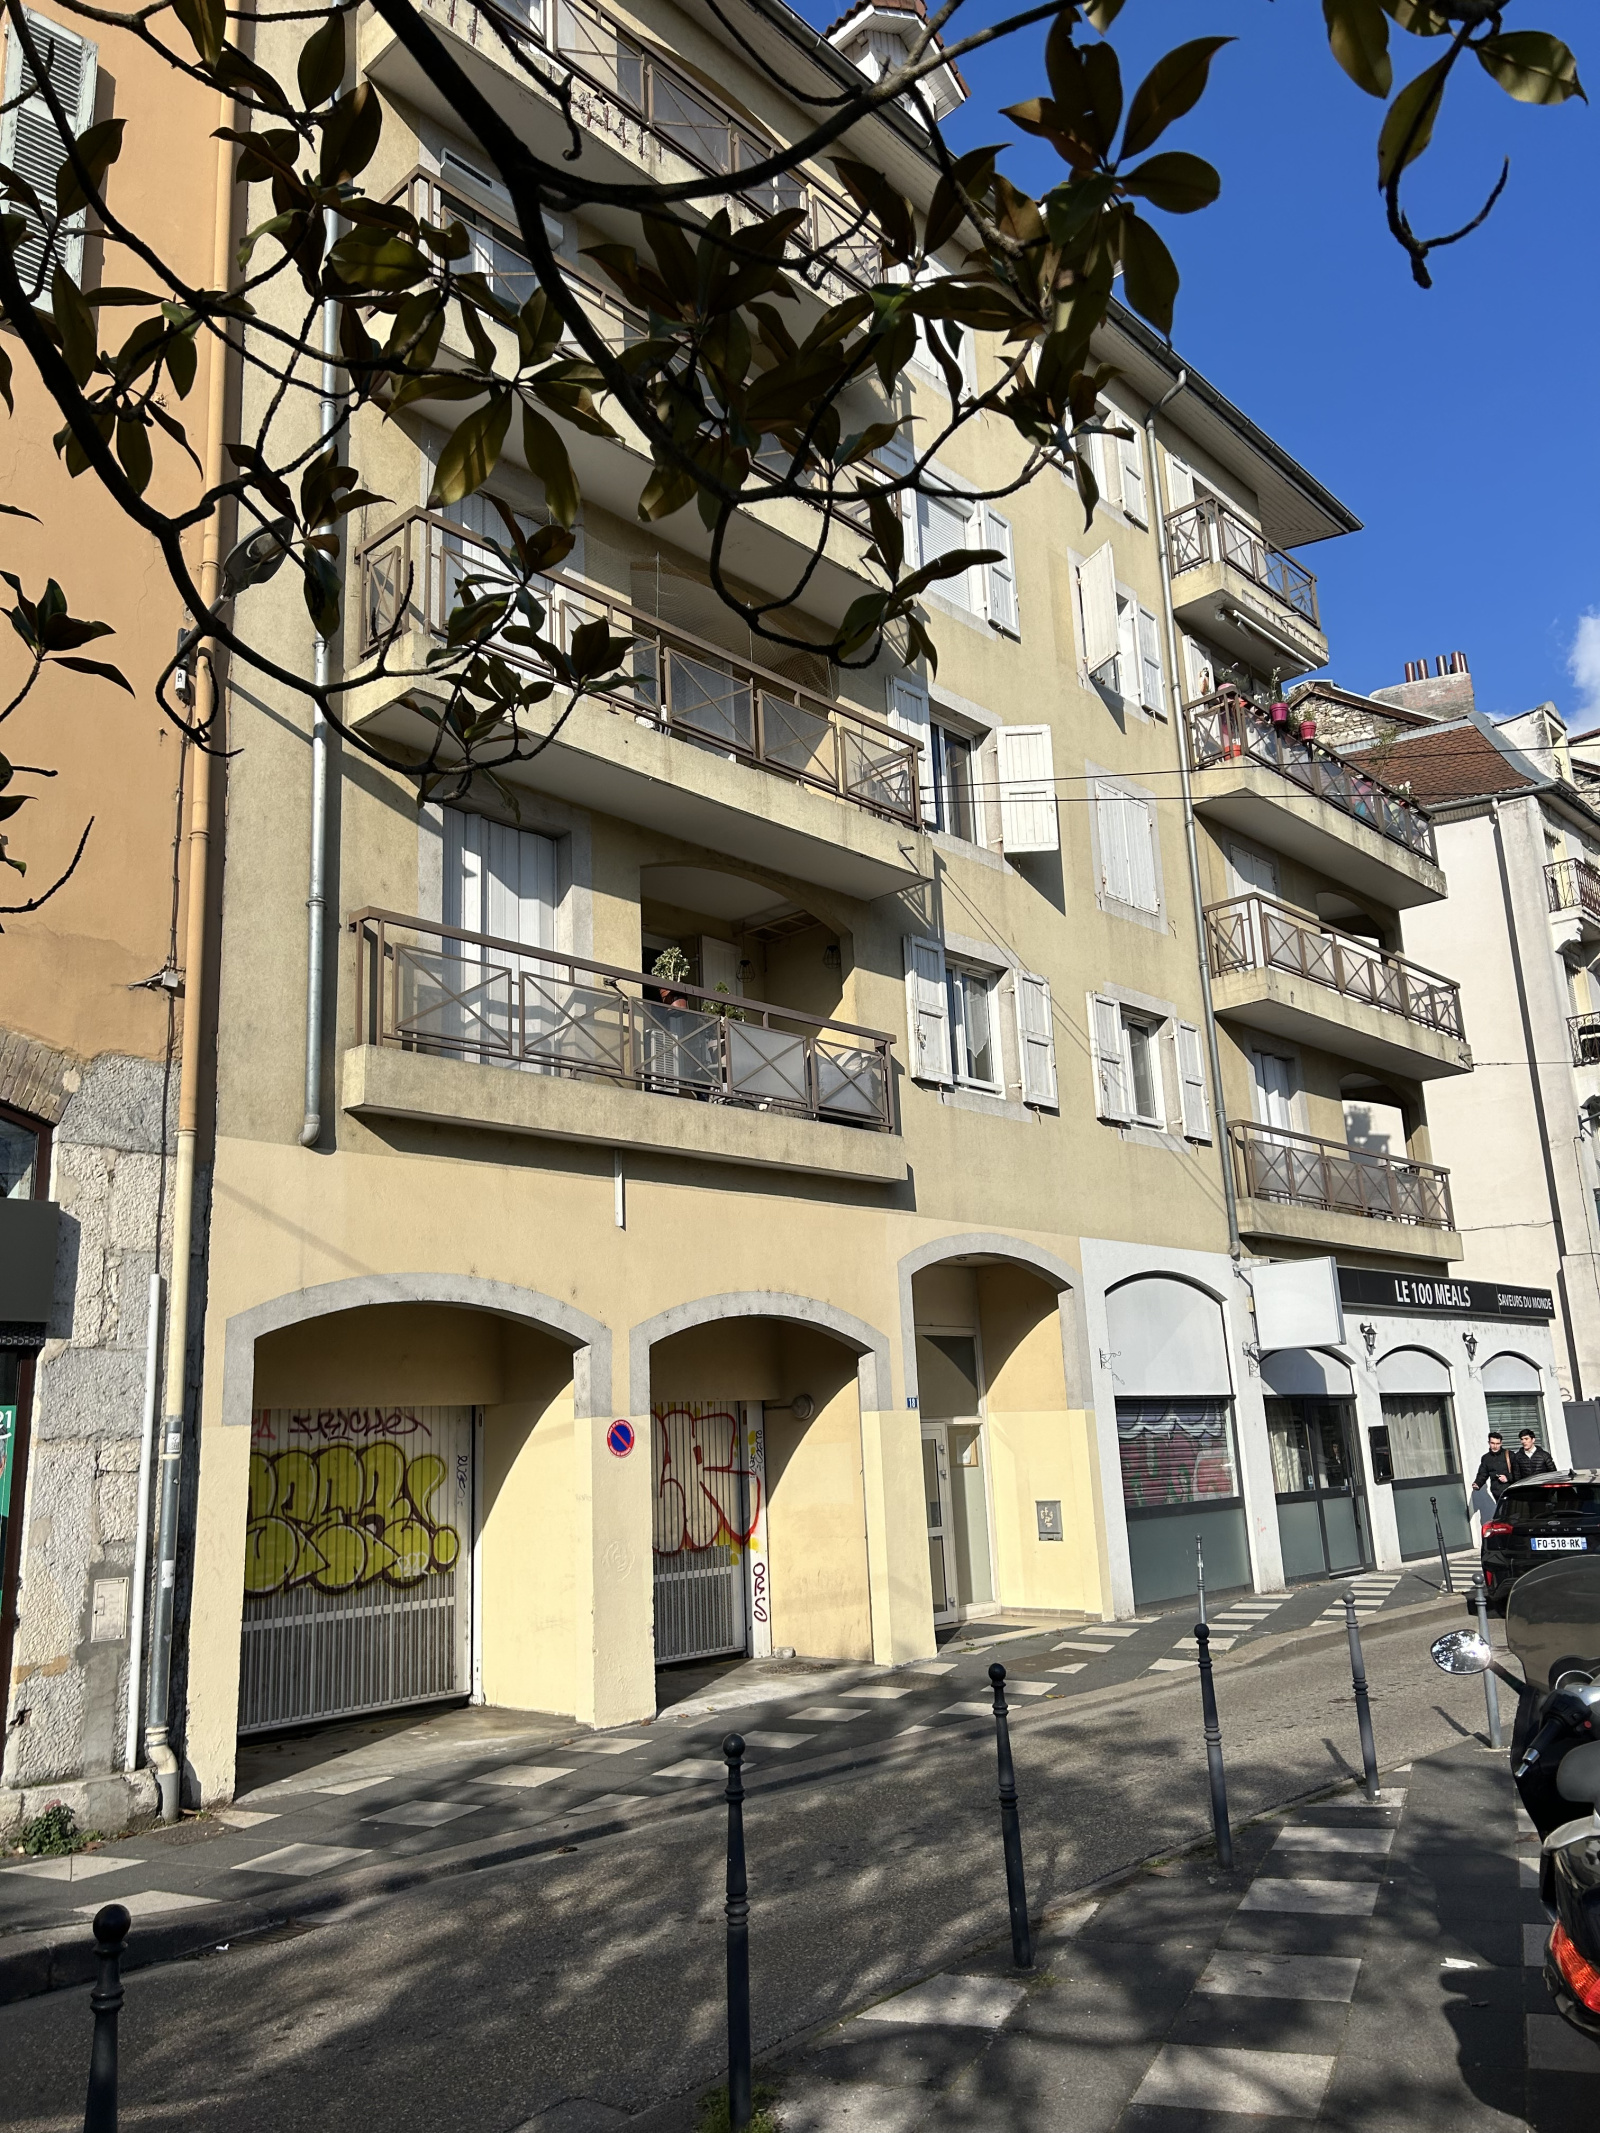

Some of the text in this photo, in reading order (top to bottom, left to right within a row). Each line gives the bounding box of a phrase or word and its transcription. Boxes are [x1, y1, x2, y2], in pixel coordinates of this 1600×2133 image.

[1394, 1279, 1471, 1308] LE 100 MEALS
[1498, 1293, 1553, 1310] SAVEURS DU MONDE
[908, 1397, 916, 1408] 18
